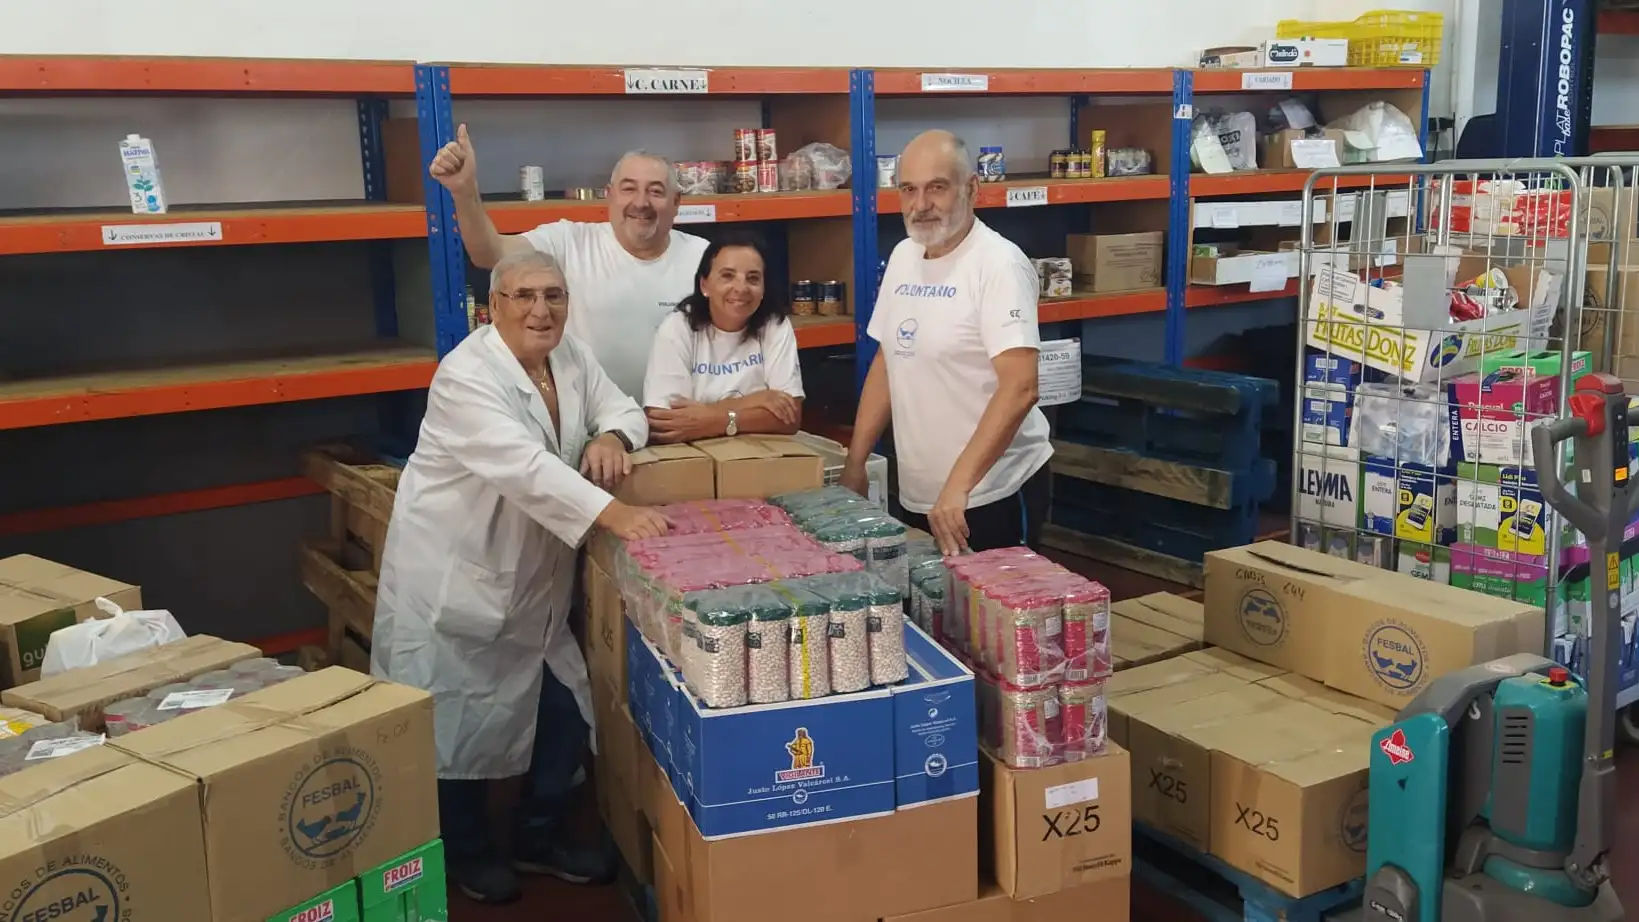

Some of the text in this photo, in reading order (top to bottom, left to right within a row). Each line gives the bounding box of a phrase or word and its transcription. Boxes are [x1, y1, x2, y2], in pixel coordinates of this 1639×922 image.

[1557, 8, 1574, 110] ROBOPAC
[635, 79, 700, 90] C. CARNE
[894, 283, 957, 298] VOLUNTARIO
[1451, 410, 1460, 441] ENTERA
[1465, 422, 1508, 433] CALCIO
[1299, 467, 1353, 502] LEYMA
[1372, 485, 1392, 495] ENTERA
[23, 648, 44, 668] gu
[1377, 636, 1415, 656] FESBAL
[302, 774, 361, 809] FESBAL
[747, 787, 770, 795] Justo
[1148, 767, 1188, 804] X25
[1041, 805, 1101, 842] X25
[1235, 801, 1279, 841] X25
[35, 860, 57, 879] DE
[61, 853, 130, 893] ALIMENTOS
[384, 858, 421, 886] FROIZ
[22, 885, 101, 922] FESBAL
